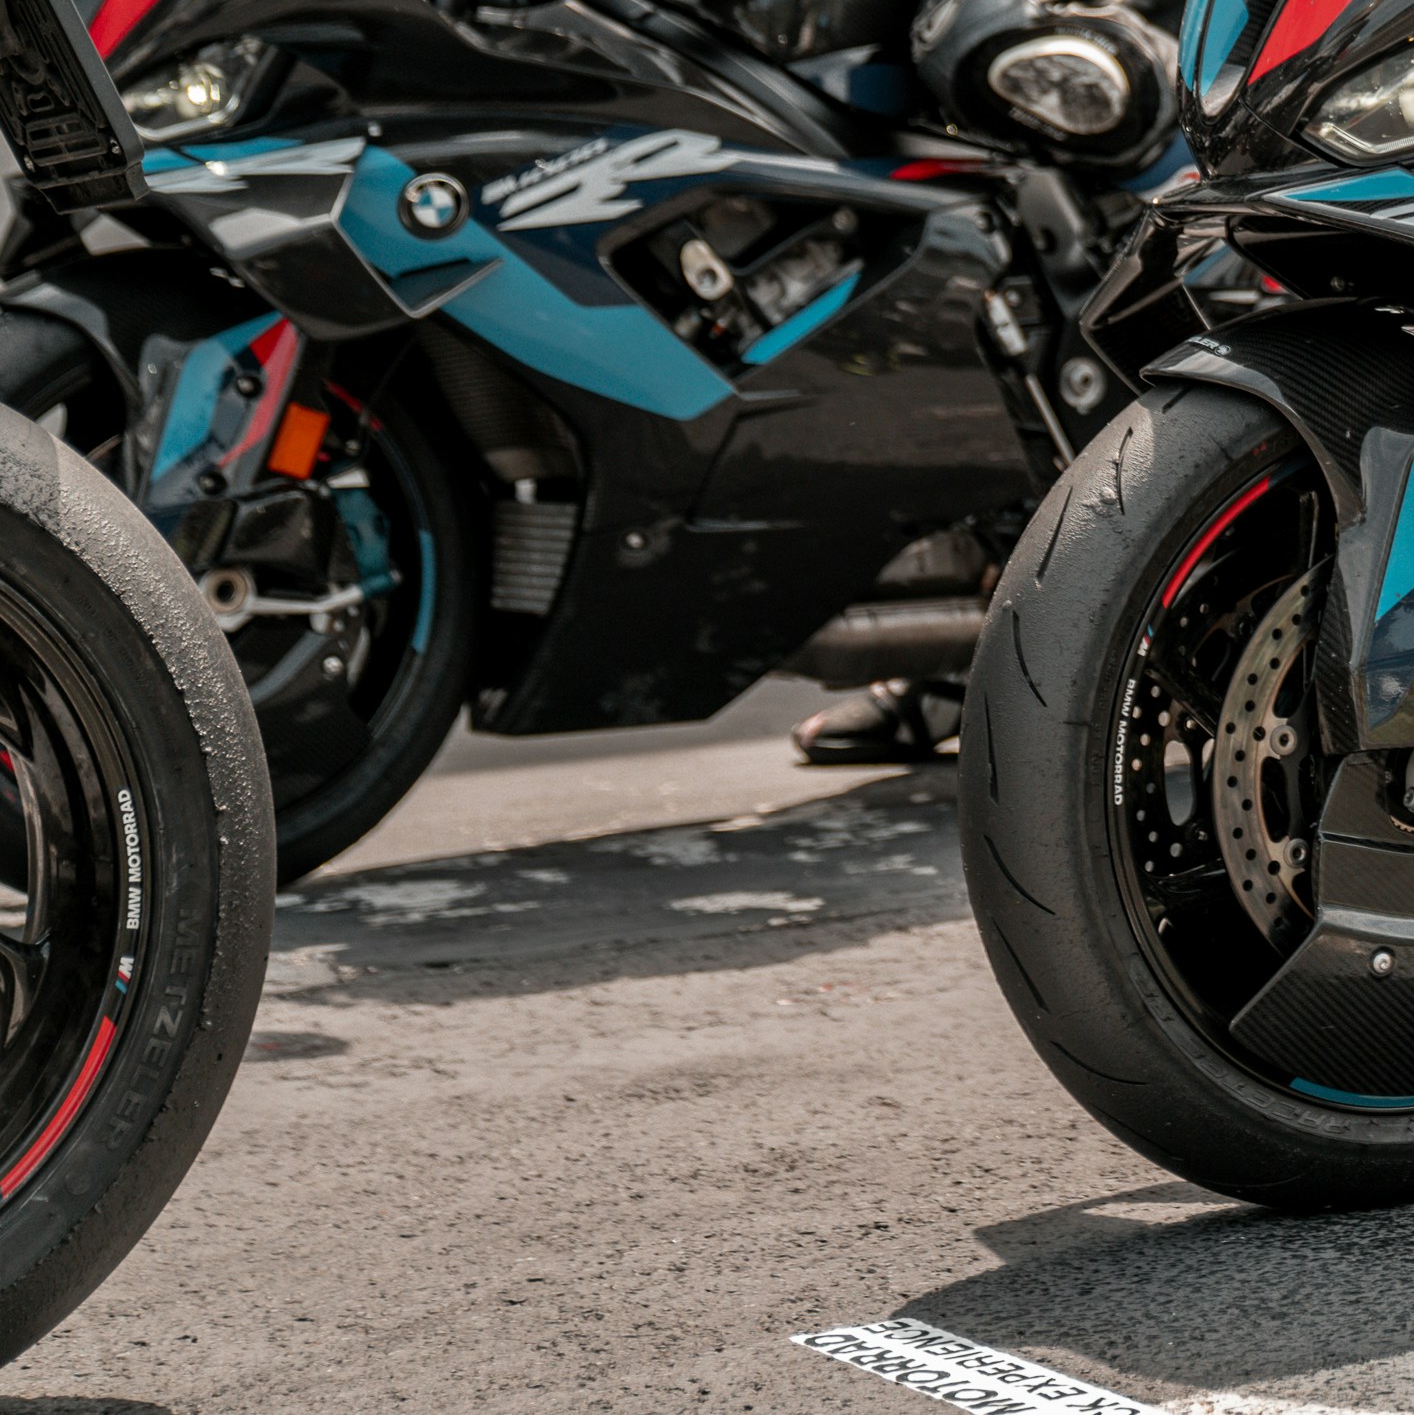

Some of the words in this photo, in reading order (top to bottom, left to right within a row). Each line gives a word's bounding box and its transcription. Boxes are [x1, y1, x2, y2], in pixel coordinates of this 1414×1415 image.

[1122, 677, 1136, 718] BMW
[1113, 719, 1128, 806] MOTORRAD
[118, 788, 143, 884] MOTORRAD
[126, 887, 142, 930] BMW
[803, 1333, 1038, 1415] MOTORRAD
[862, 1320, 1088, 1403] EXPERIENCE
